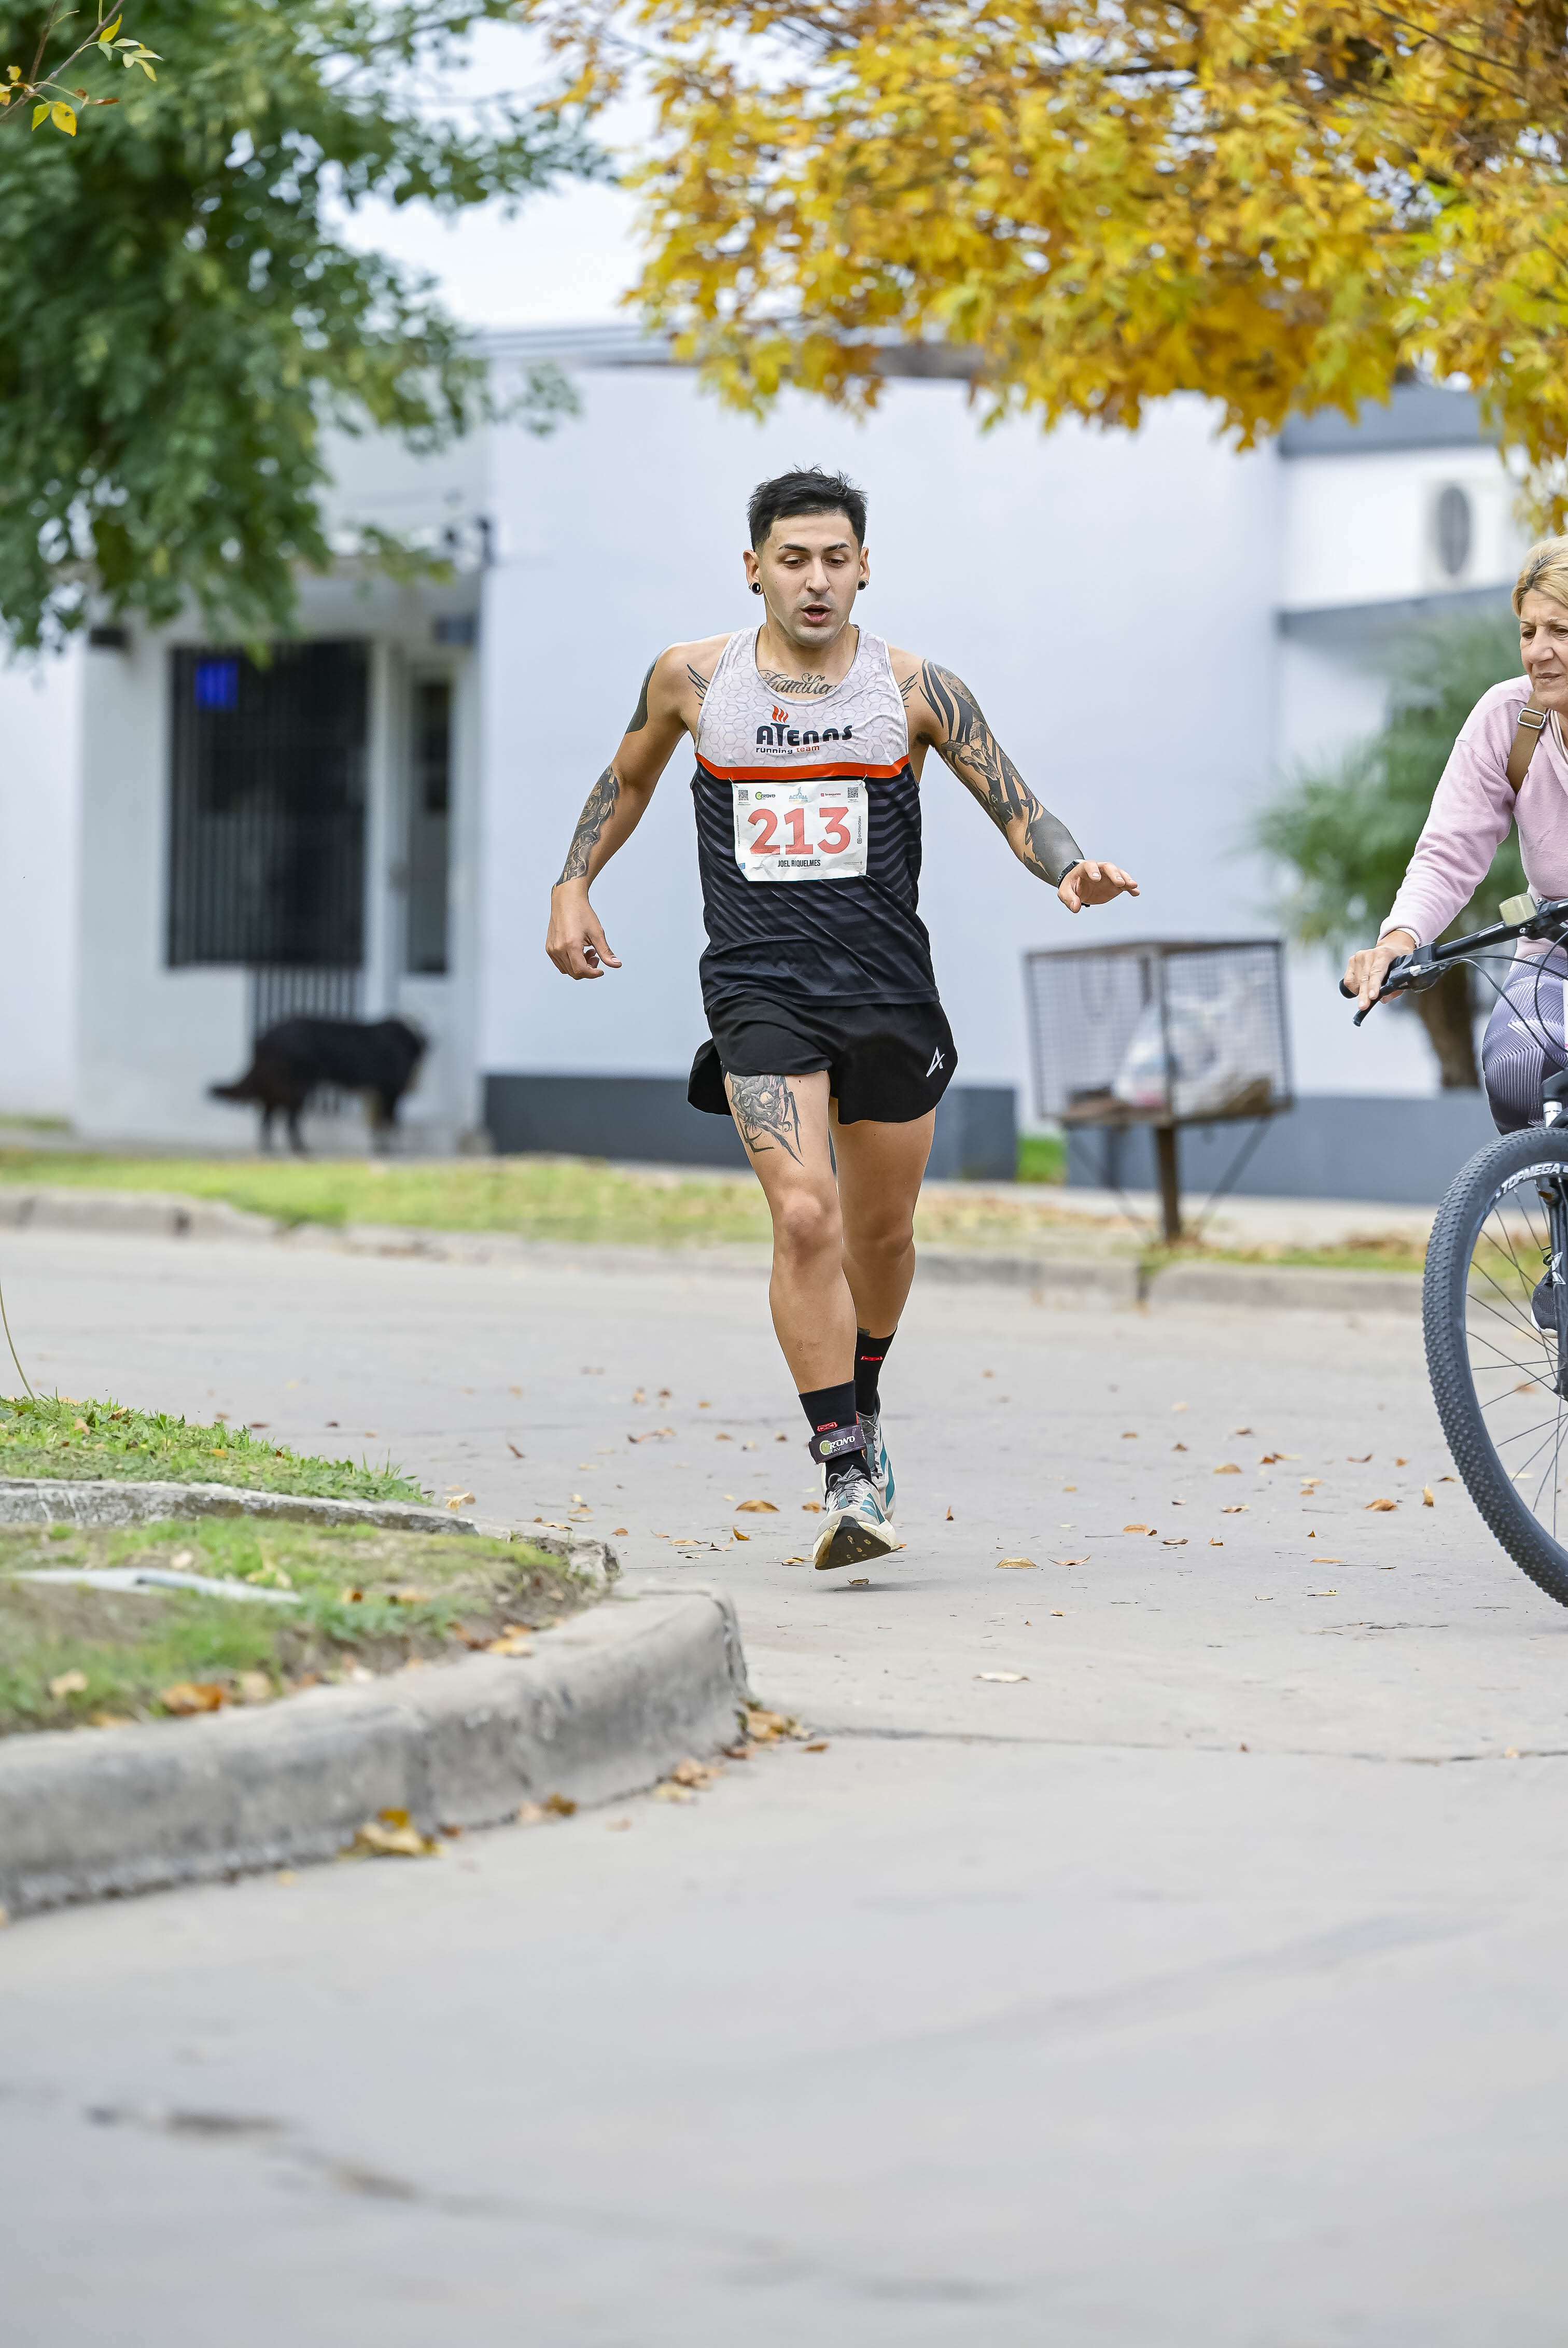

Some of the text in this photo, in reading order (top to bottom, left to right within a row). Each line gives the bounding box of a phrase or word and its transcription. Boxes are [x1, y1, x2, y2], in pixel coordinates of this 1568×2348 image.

[747, 807, 851, 855] 213
[791, 859, 821, 868] RIQUELMES
[1501, 1163, 1561, 1194] TOPMEGA
